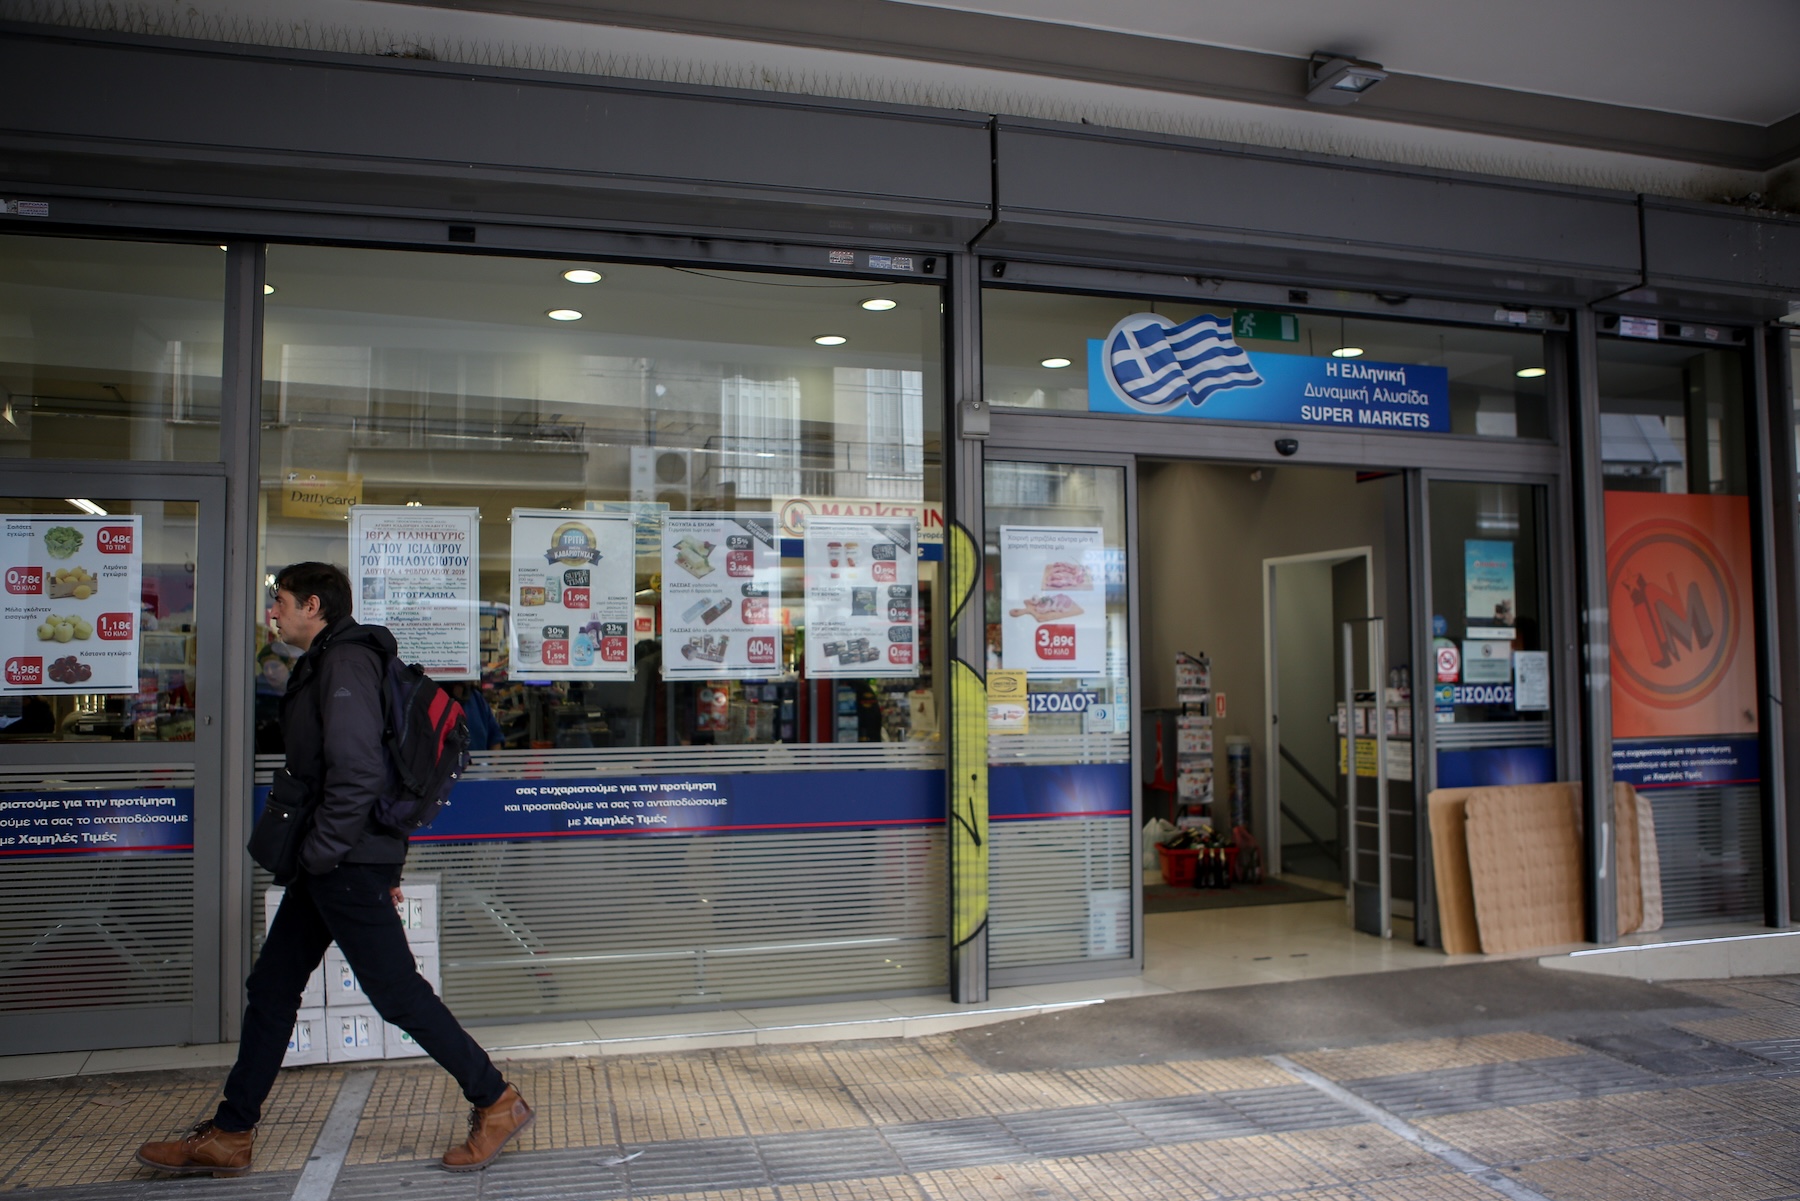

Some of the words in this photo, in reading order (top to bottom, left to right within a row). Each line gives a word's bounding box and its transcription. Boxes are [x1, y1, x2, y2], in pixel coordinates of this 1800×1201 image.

[1326, 362, 1338, 376] Η
[1341, 364, 1406, 386] Ελληνική
[1304, 382, 1369, 404] Δυναμική
[1373, 387, 1428, 405] Αλυσίδα
[1301, 406, 1353, 422] SUPER
[1358, 409, 1430, 428] MARKETS
[924, 508, 944, 527] IN
[99, 530, 130, 544] 0,48€
[369, 543, 402, 554] ΑΓΙΟΥ
[361, 556, 381, 566] ΤΟΥ
[7, 570, 40, 585] 0,78€
[101, 617, 130, 631] 1,18€
[1038, 630, 1073, 648] 3,89€
[749, 640, 773, 655] 40%
[8, 660, 40, 675] 4,98€
[1454, 686, 1513, 703] ΕΙΣΟΔΟΣ
[516, 786, 537, 796] σας
[540, 784, 618, 796] ευχαριστούμε
[620, 784, 636, 794] για
[639, 784, 658, 793] την
[660, 781, 716, 792] προτίμηση
[63, 799, 82, 809] για
[85, 797, 107, 809] την
[110, 796, 176, 807] προτίμηση
[522, 801, 594, 812] προσπαθούμε
[611, 801, 629, 810] σας
[646, 797, 728, 808] ανταποδώσουμε
[0, 817, 31, 828] ούμε
[51, 818, 73, 827] σας
[94, 814, 188, 824] ανταποδώσουμε
[568, 818, 581, 827] με
[583, 815, 634, 826] Χαμηλές
[636, 814, 667, 824] Τιμές
[0, 836, 15, 846] με
[18, 832, 78, 846] Χαμηλές
[81, 832, 117, 843] Τιμές
